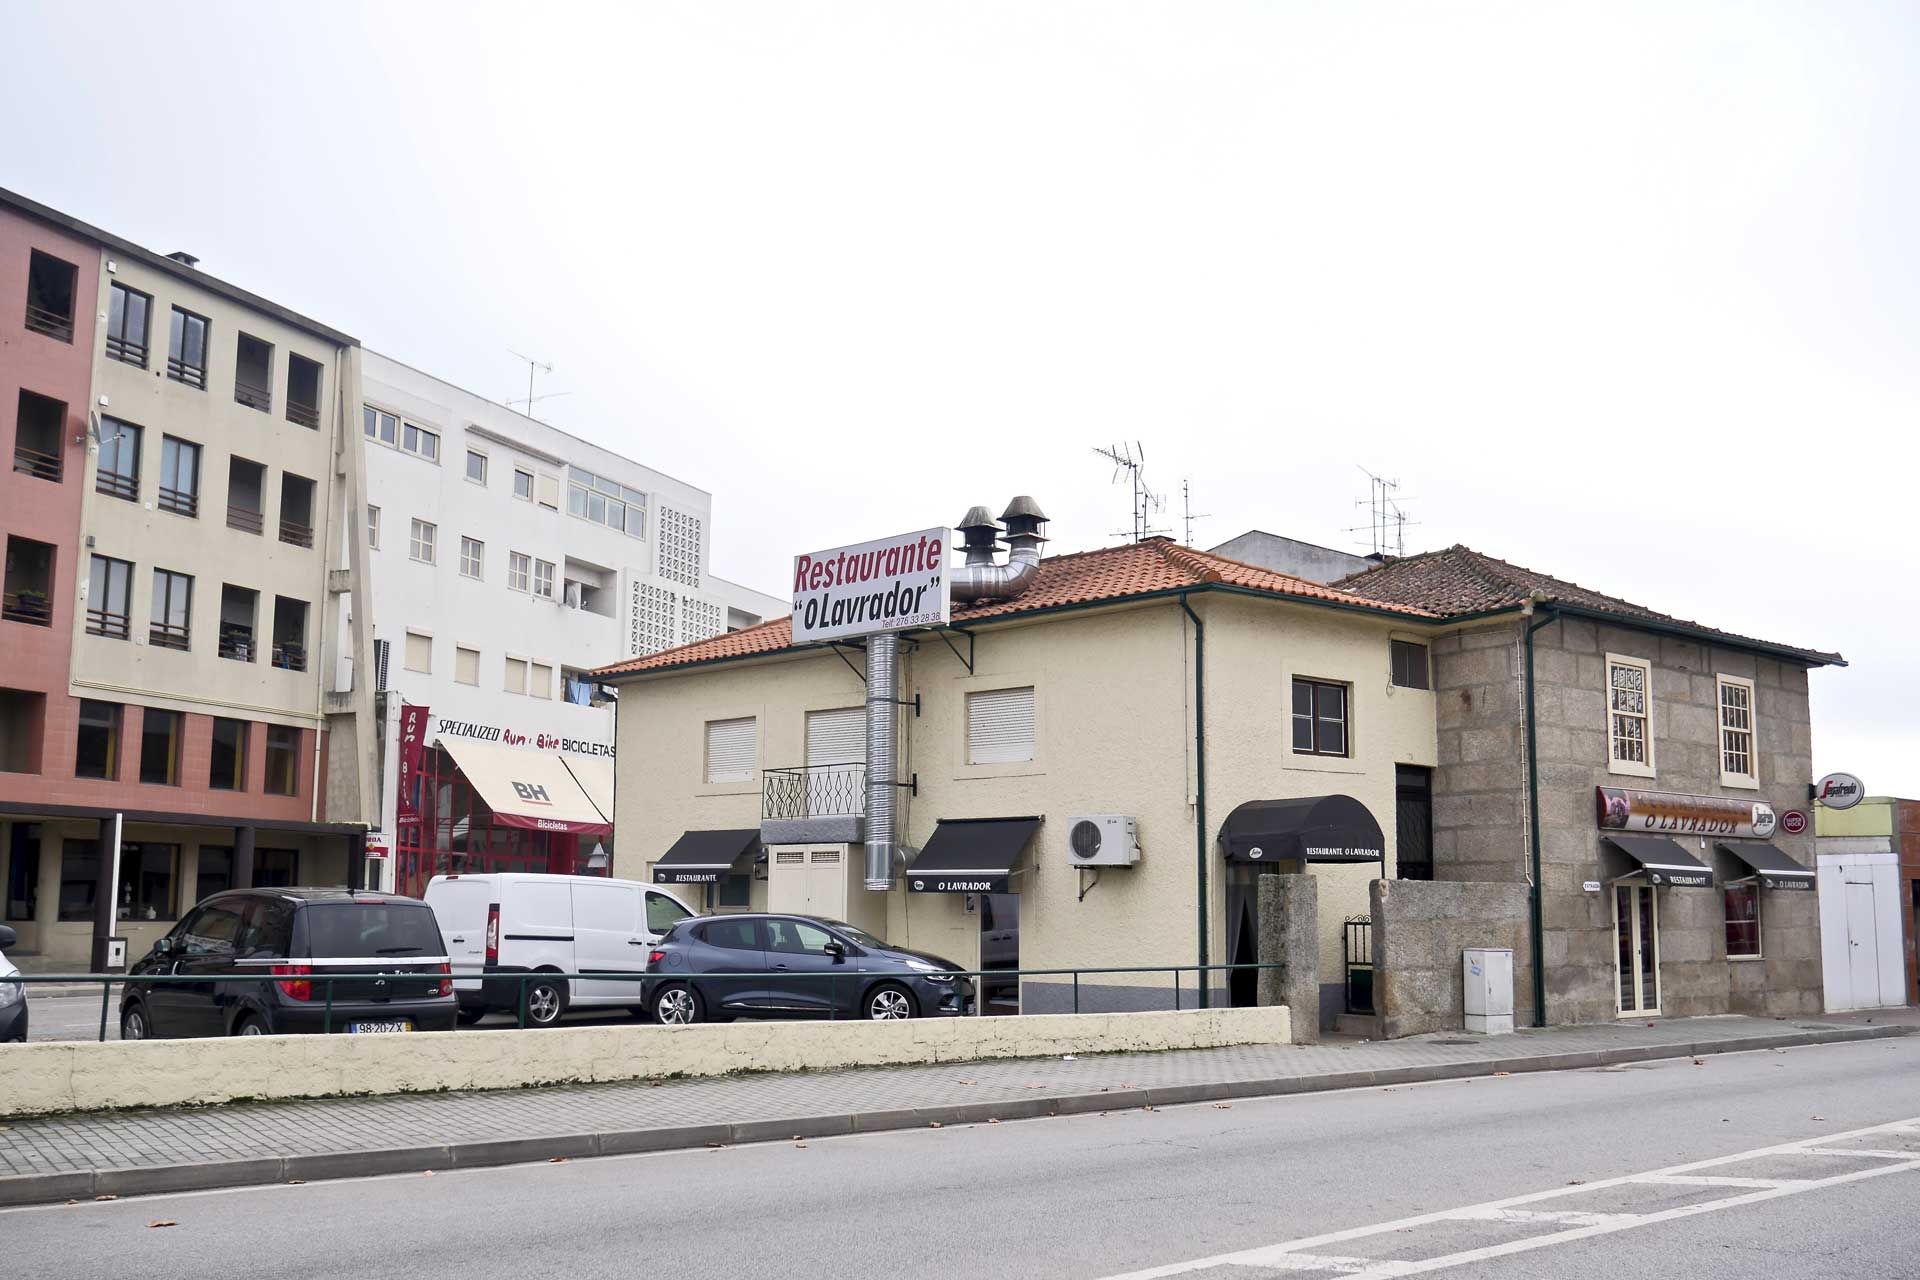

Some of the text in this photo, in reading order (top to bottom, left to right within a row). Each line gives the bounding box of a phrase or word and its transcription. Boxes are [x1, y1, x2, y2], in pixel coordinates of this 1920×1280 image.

[794, 535, 943, 593] Restaurante
[437, 719, 616, 758] SPECIALIZED Run Bike BICICLETAS
[512, 781, 551, 802] BH
[537, 819, 568, 831] Bicicletas
[1645, 814, 1656, 828] O
[1660, 815, 1739, 834] LAVRADOR
[1306, 847, 1343, 855] RESTAURANTE
[1350, 848, 1380, 857] LAVRADOR
[676, 874, 717, 882] RESTAURANTE
[938, 882, 991, 891] O LAVRADOR
